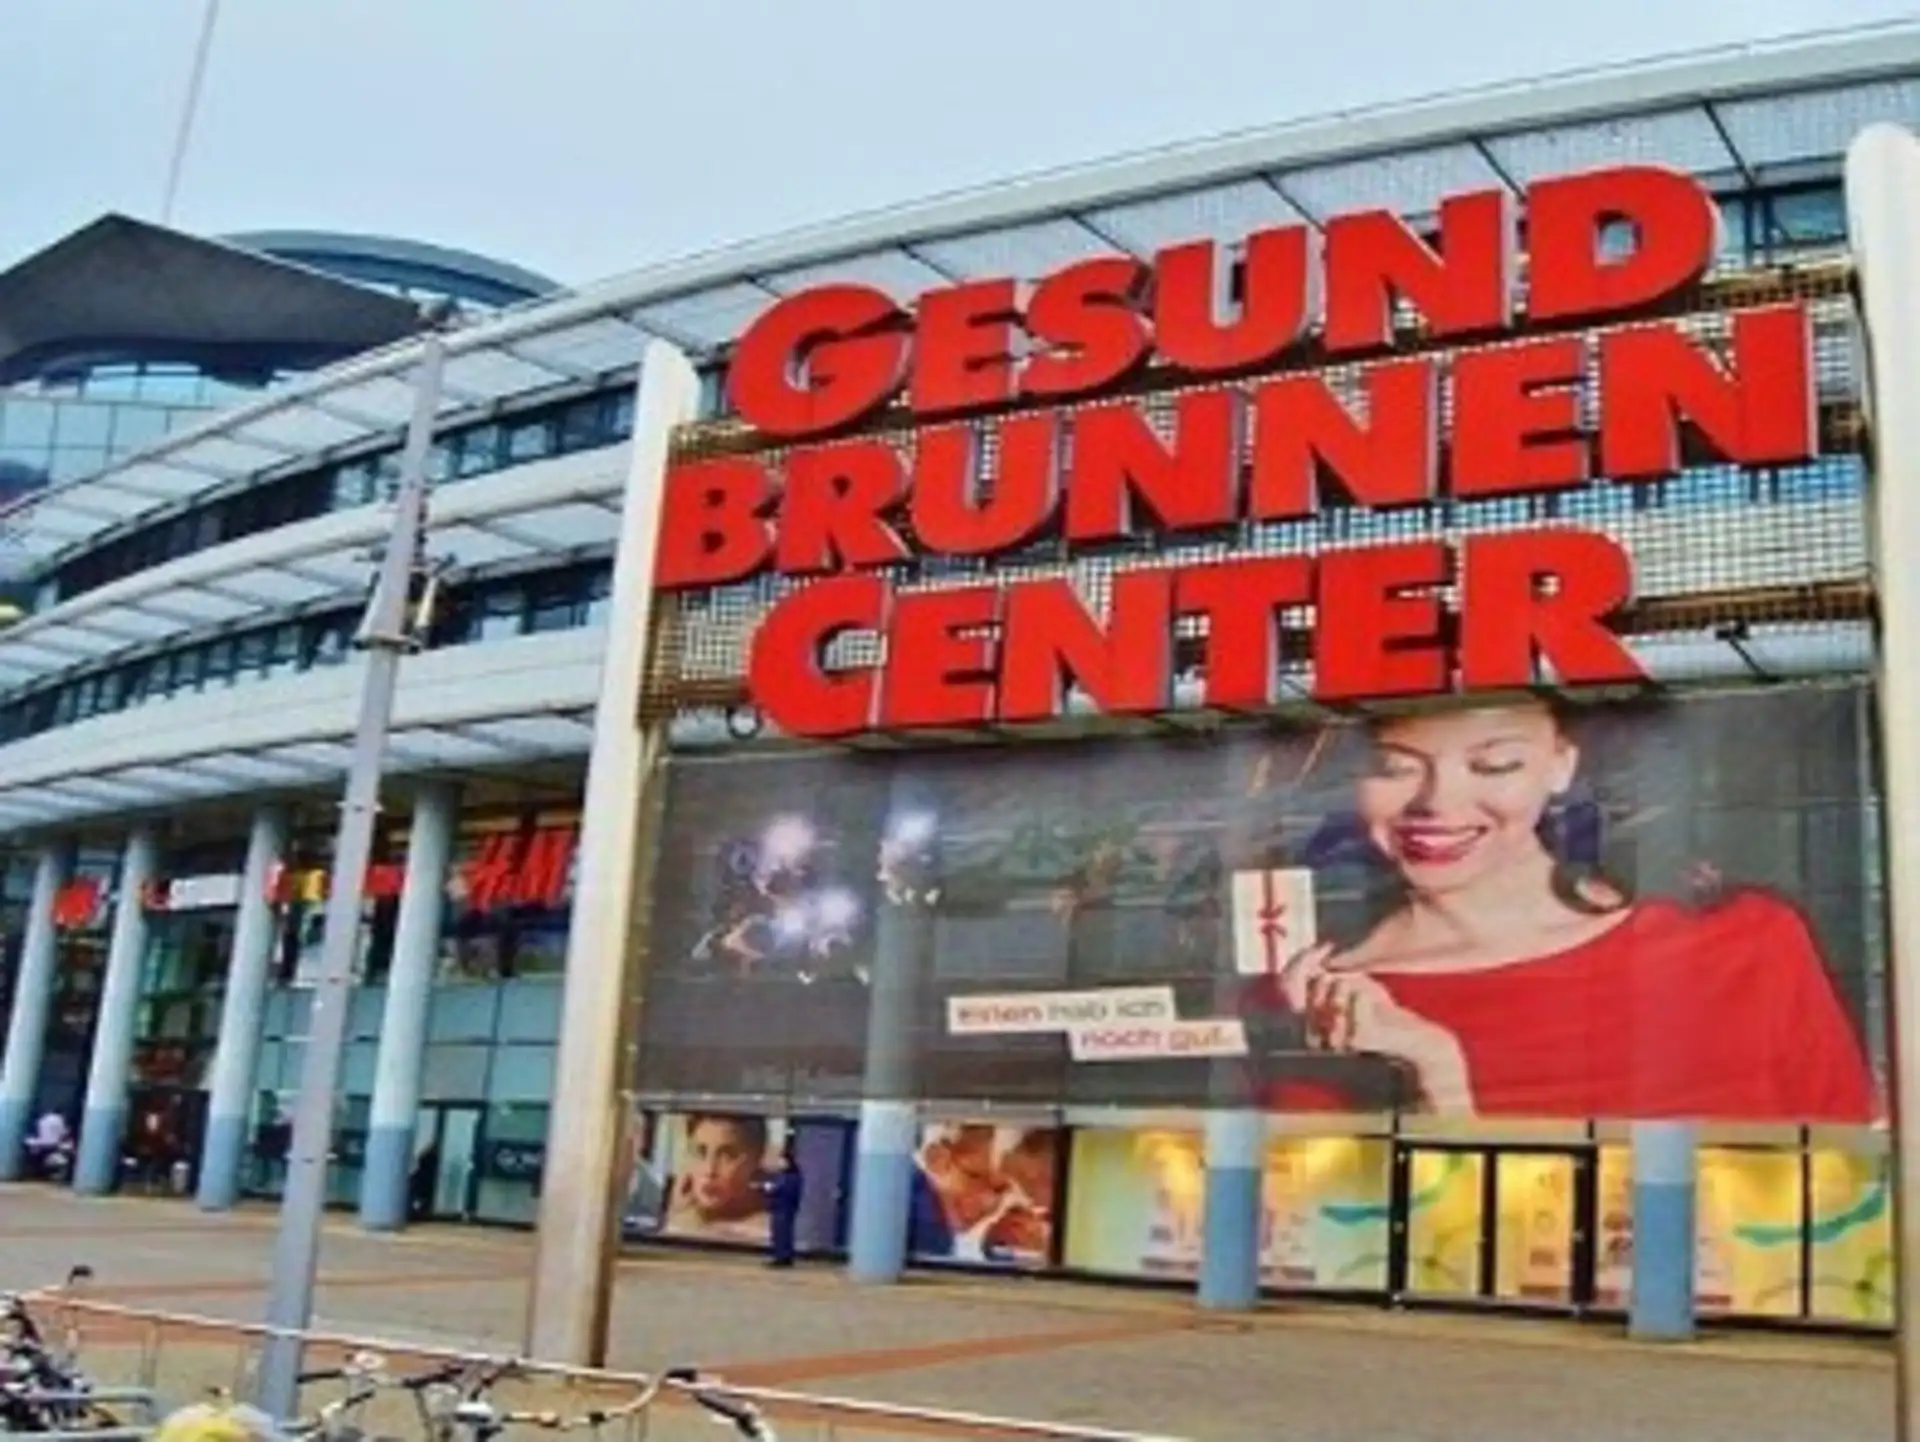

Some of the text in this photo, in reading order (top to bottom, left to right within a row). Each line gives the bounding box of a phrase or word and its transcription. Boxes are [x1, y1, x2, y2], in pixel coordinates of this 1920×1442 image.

[728, 166, 1720, 436] GESUND
[654, 306, 1818, 588] BRUNNEN
[746, 528, 1650, 736] CENTER
